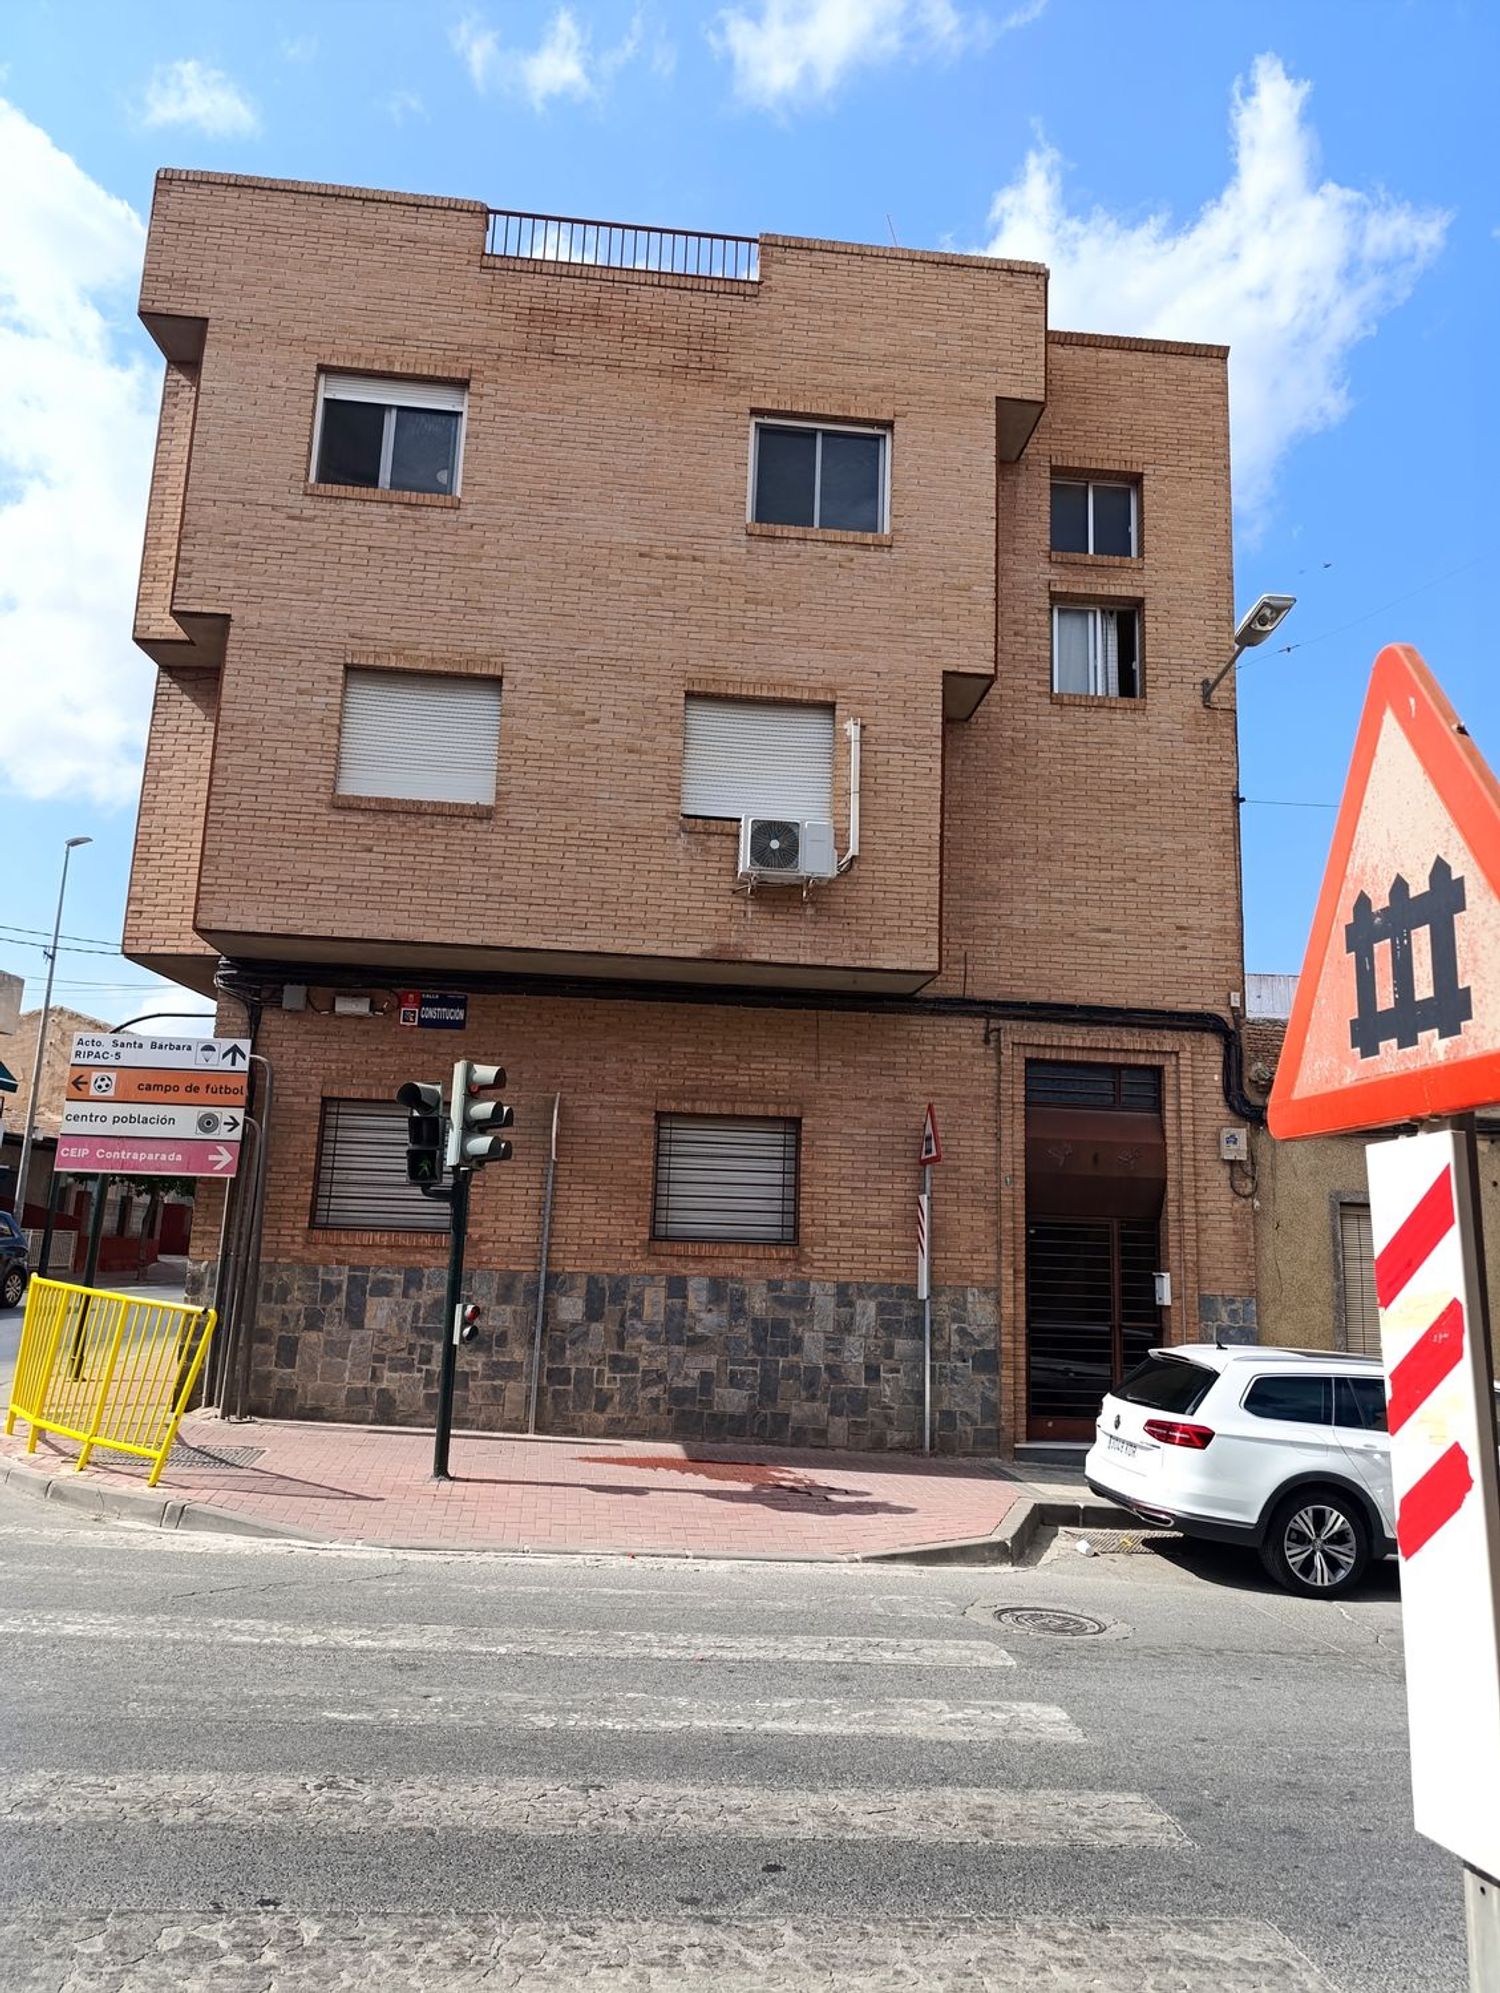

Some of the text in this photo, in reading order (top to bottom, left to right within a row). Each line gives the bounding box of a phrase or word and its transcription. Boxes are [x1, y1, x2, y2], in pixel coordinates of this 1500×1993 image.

[420, 1006, 465, 1020] CONSTITUCIÓN
[76, 1037, 193, 1051] Acto. Santa Bárbara
[74, 1050, 121, 1060] RIPAC-5
[136, 1082, 244, 1095] campo de fútbol
[65, 1111, 176, 1126] centro población
[60, 1147, 183, 1162] CEIP Contraparada
